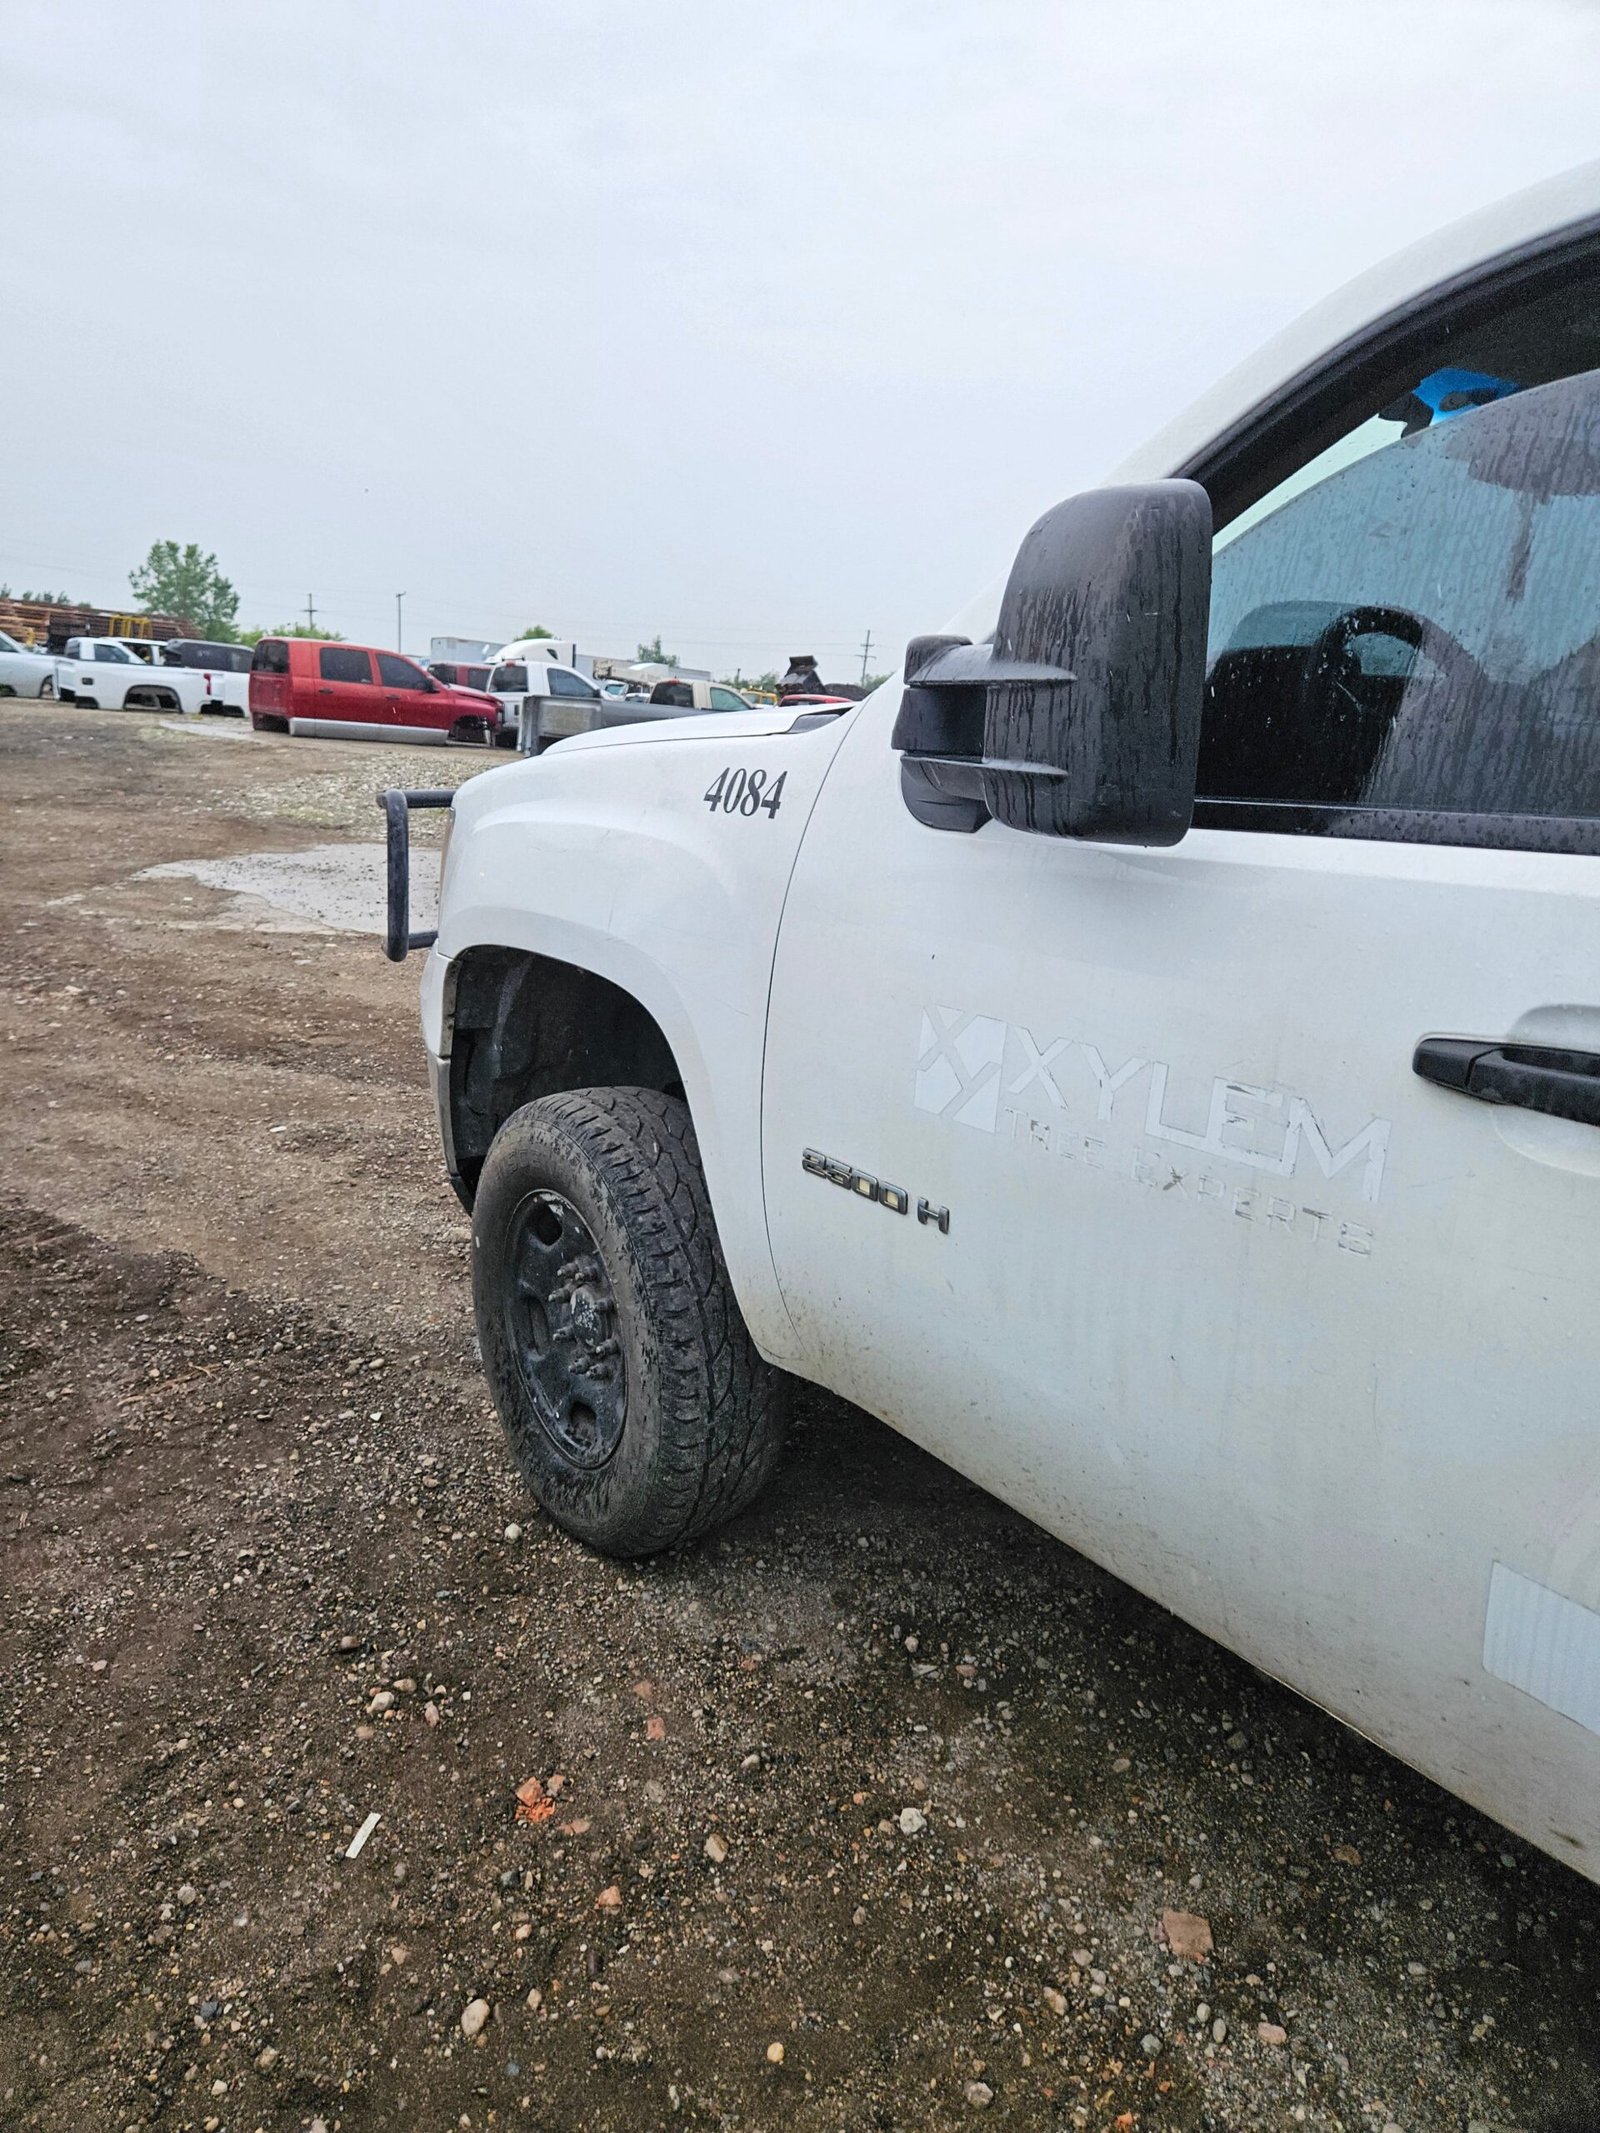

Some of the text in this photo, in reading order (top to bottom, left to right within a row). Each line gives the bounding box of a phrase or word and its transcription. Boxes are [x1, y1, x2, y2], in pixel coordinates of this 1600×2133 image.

[704, 767, 788, 819] 4084
[1007, 1023, 1391, 1202] XYLEM
[802, 1148, 950, 1235] 2500 H
[1004, 1107, 1374, 1256] TREE EXPERTS
